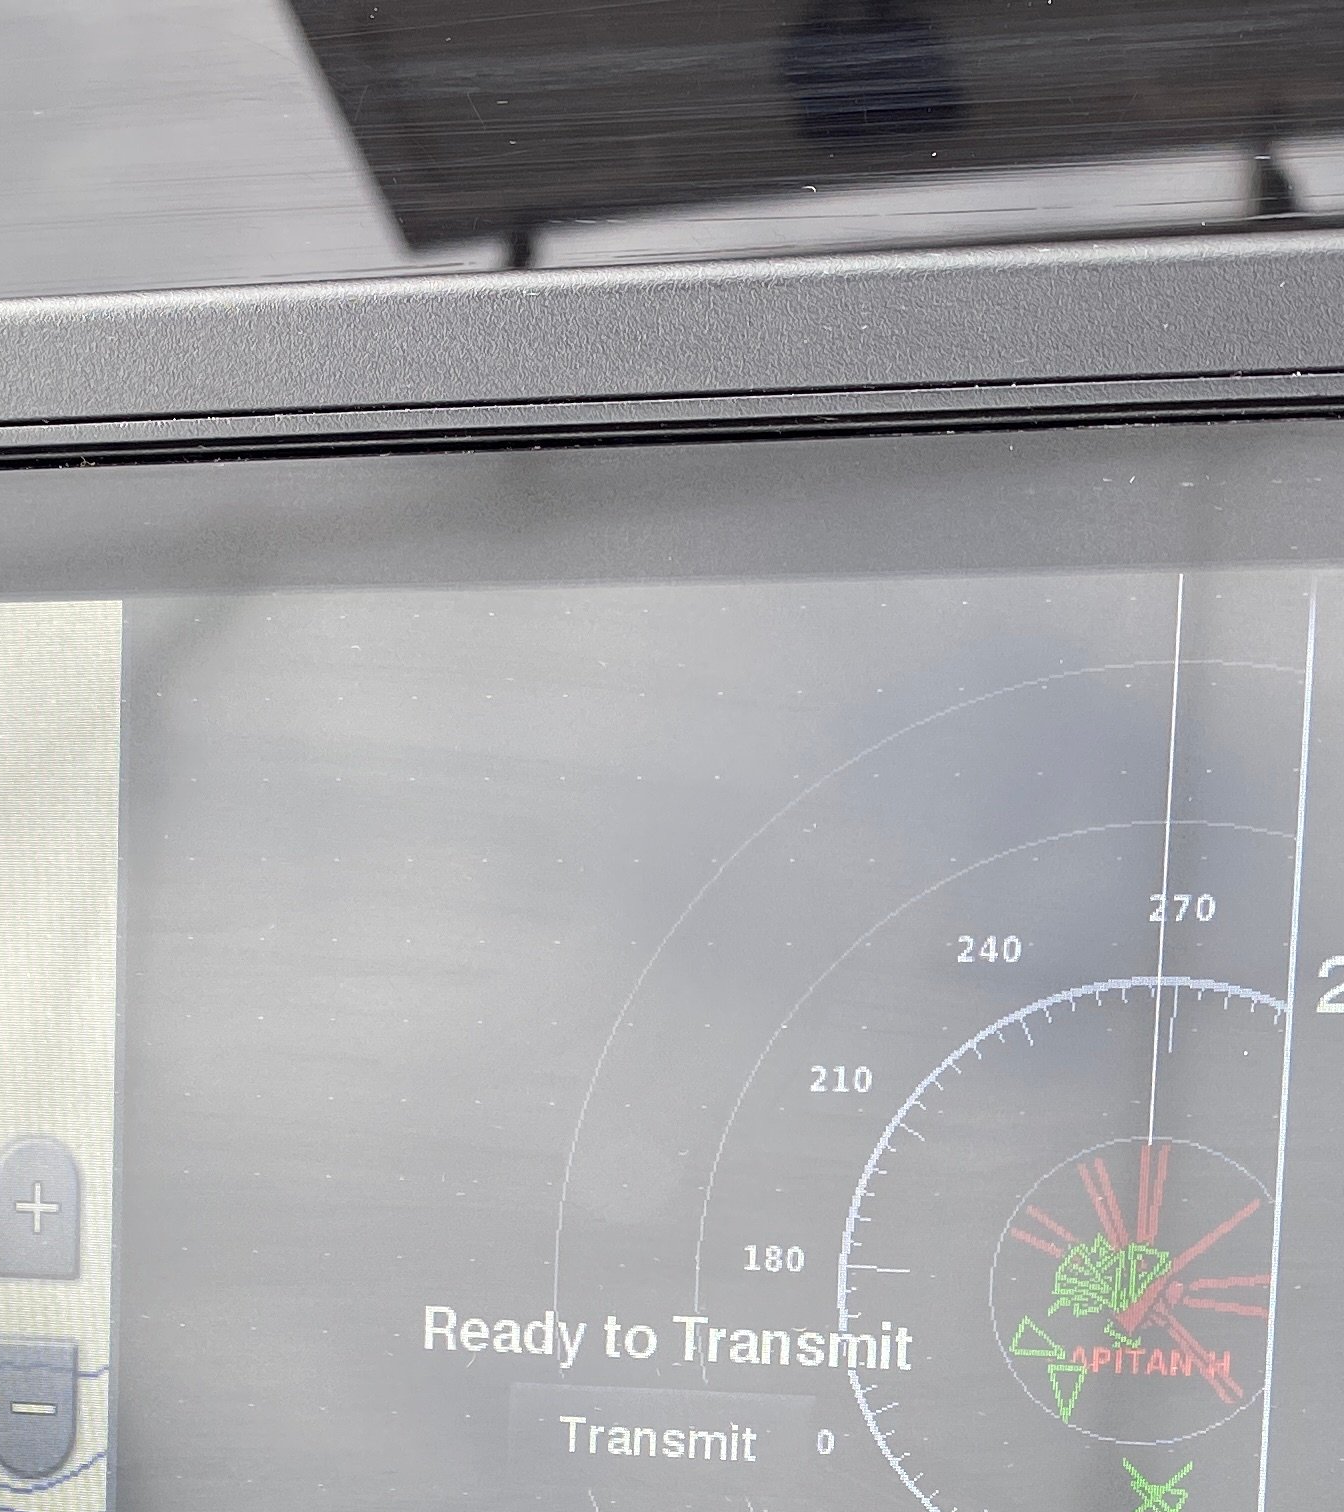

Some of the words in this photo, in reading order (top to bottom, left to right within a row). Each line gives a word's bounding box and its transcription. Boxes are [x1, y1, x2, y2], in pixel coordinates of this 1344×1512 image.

[1148, 893, 1217, 923] 270
[956, 934, 1023, 964] 240
[809, 1065, 874, 1094] 210
[742, 1244, 806, 1274] 180
[422, 1305, 587, 1369] Ready
[603, 1315, 657, 1359] to
[672, 1315, 913, 1371] Transmit
[559, 1415, 758, 1463] Transmit
